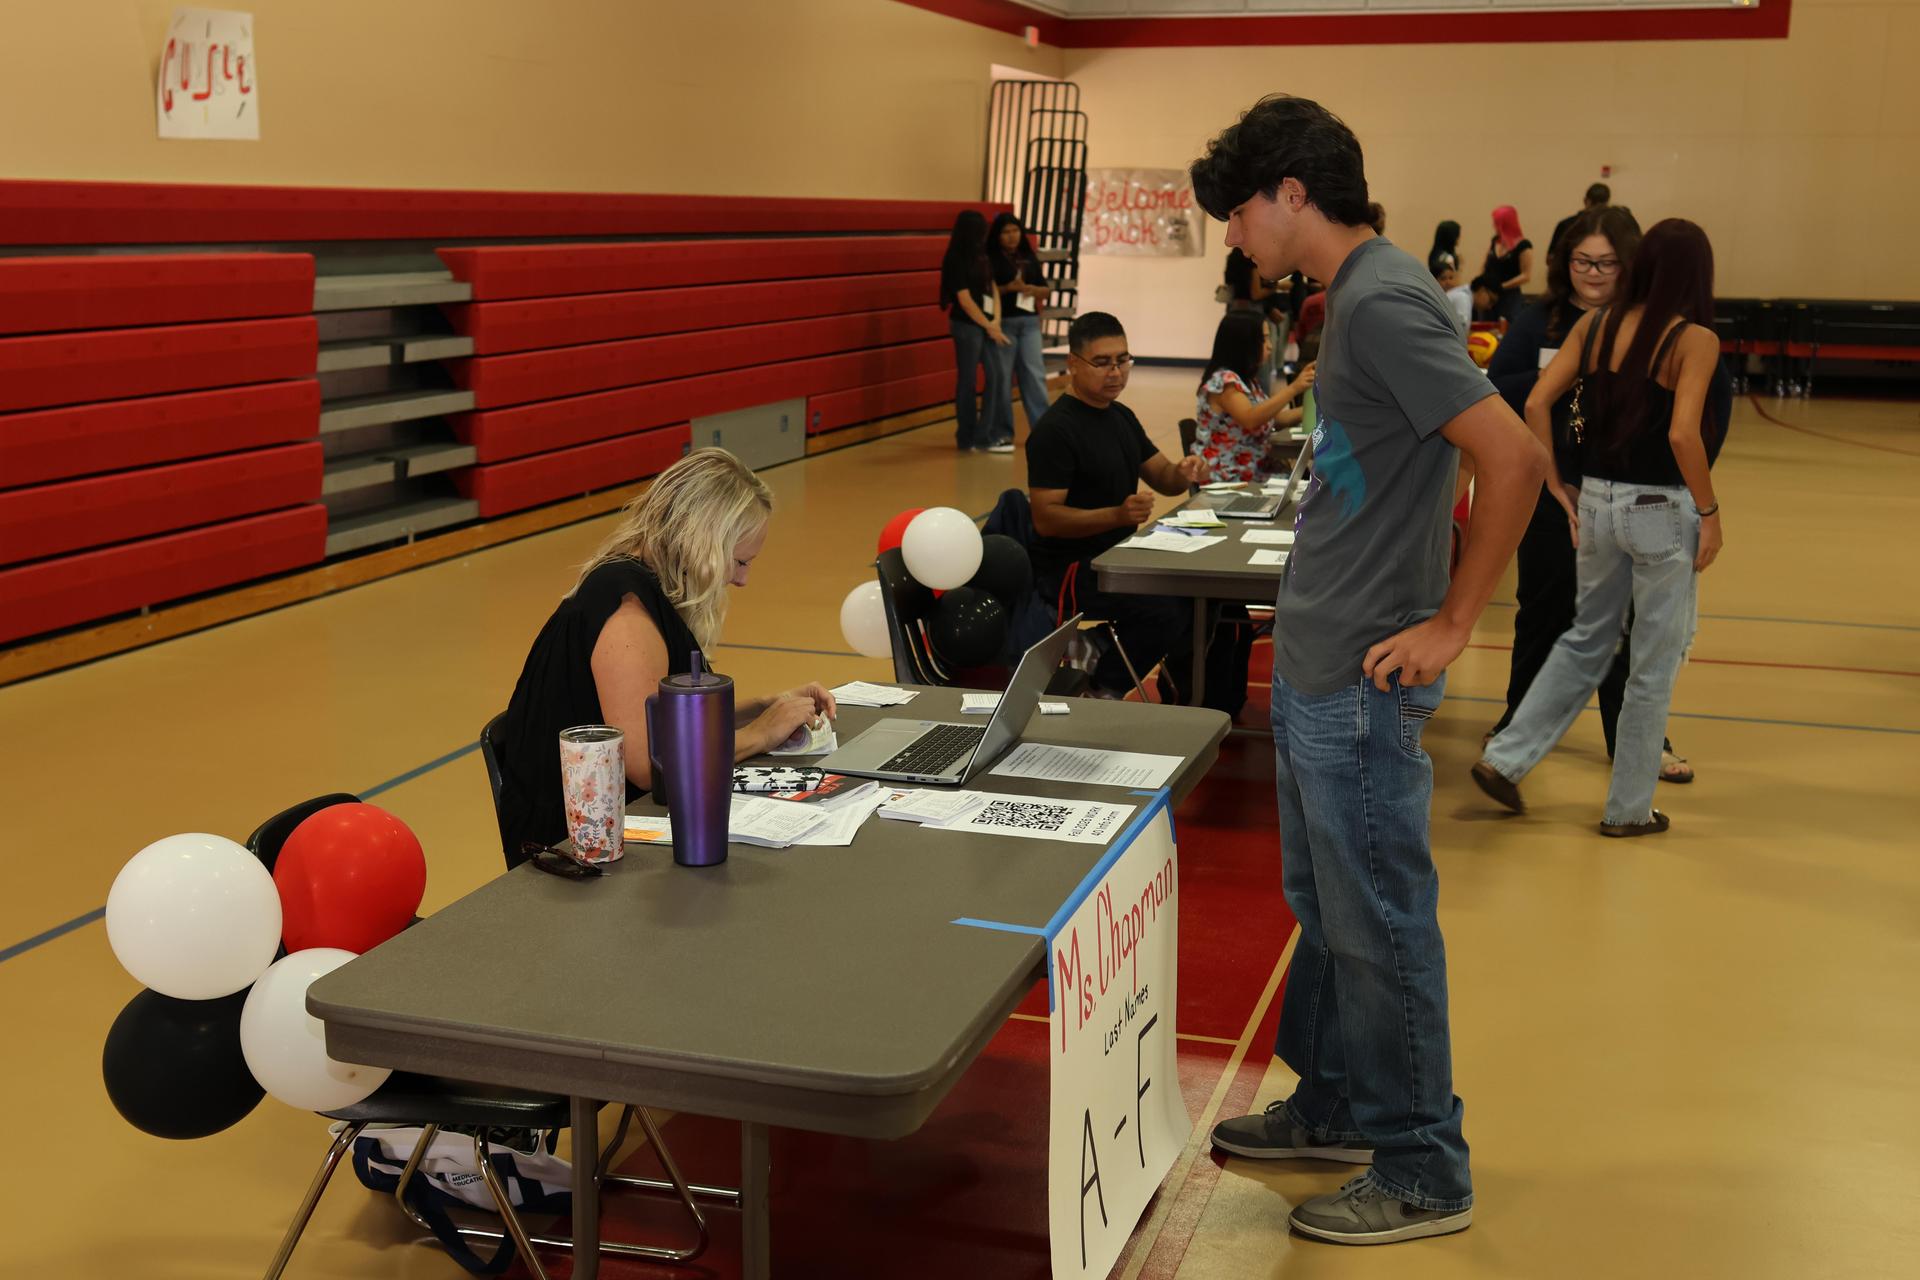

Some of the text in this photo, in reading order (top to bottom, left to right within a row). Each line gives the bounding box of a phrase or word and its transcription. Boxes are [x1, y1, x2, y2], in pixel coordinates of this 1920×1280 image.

[1097, 857, 1173, 996] Chapman
[1104, 984, 1148, 1056] Last Names
